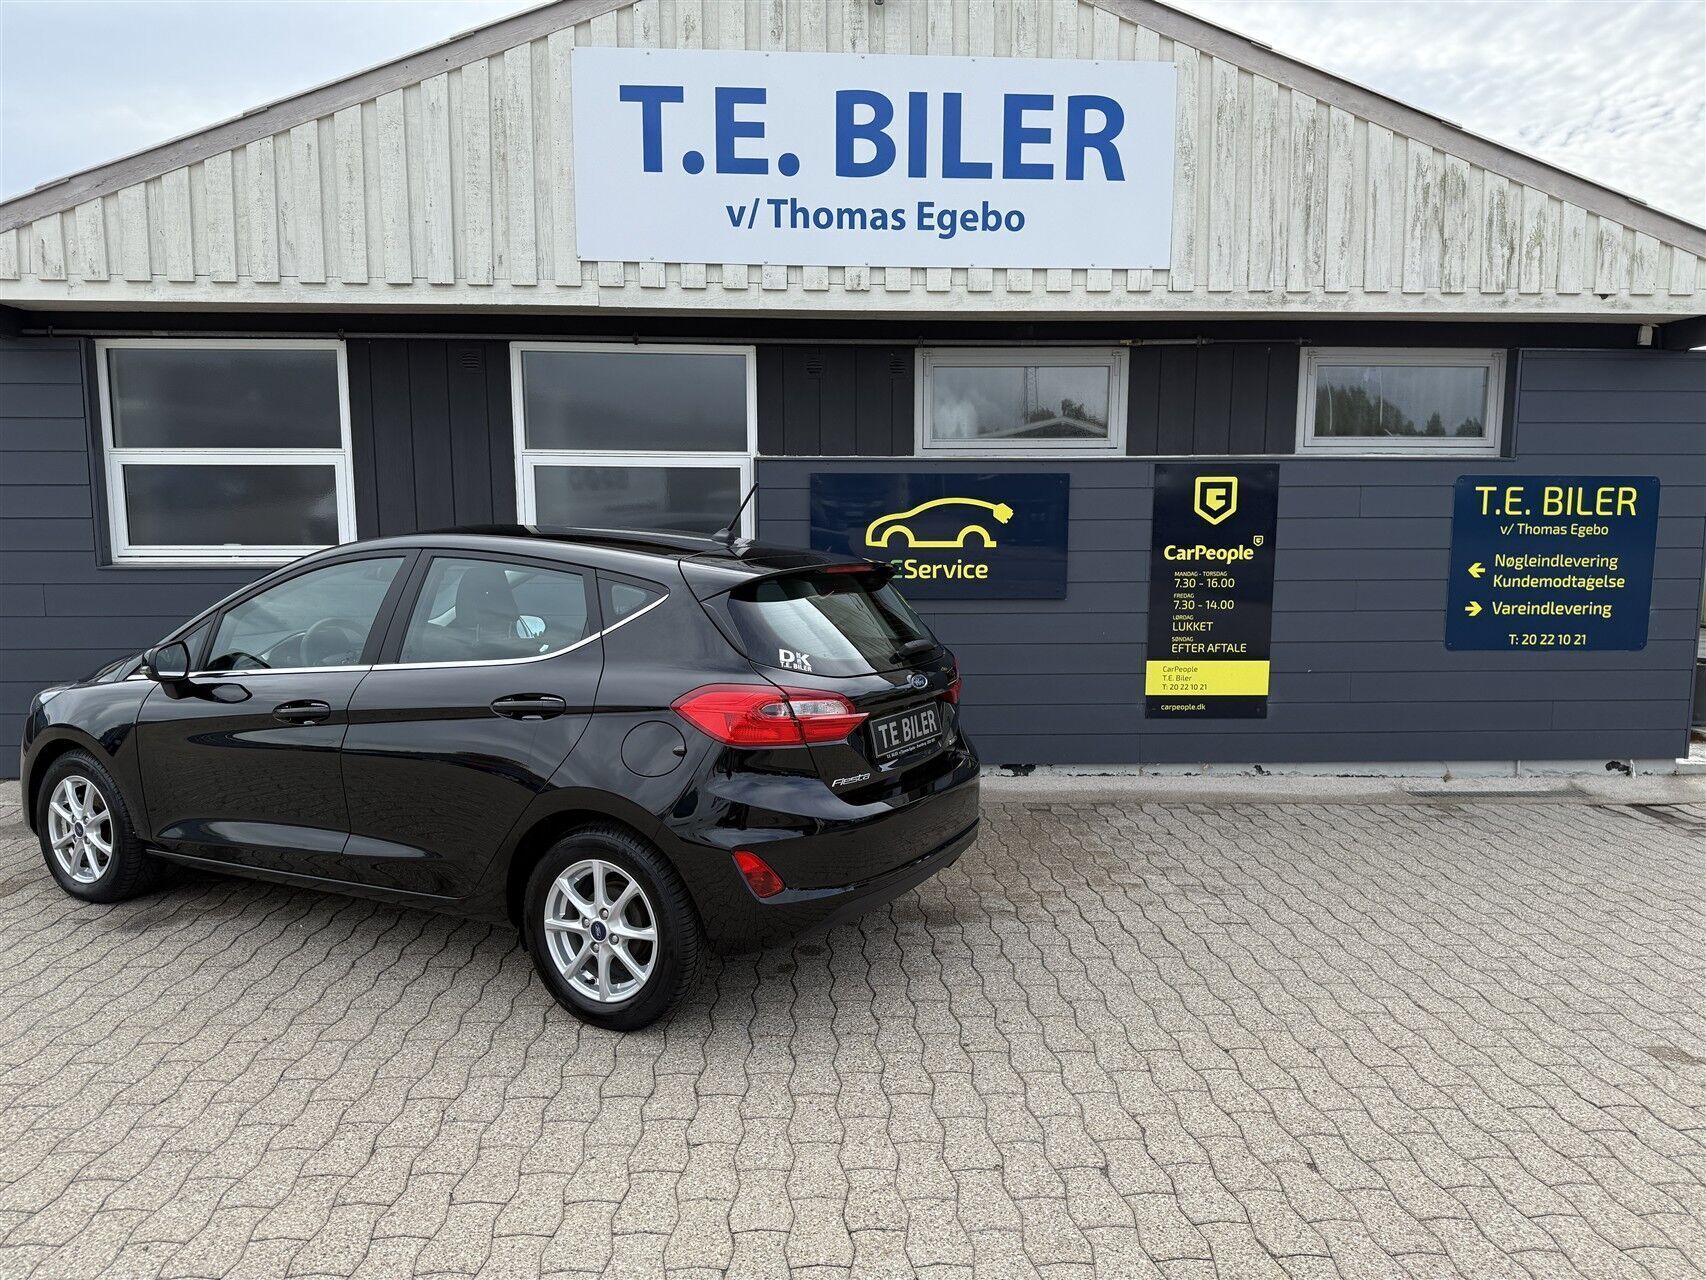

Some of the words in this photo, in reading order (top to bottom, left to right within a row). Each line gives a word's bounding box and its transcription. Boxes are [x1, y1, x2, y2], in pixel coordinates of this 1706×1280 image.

[619, 84, 801, 177] T.E.
[835, 89, 1126, 182] BILER
[725, 198, 760, 230] v/
[767, 198, 907, 232] Thomas
[916, 201, 1026, 240] Egebo
[1475, 486, 1531, 516] T.E.
[1543, 486, 1637, 516] BILER
[1500, 523, 1515, 536] v/
[1517, 523, 1567, 535] Thomas
[1570, 523, 1609, 538] Egebo
[1163, 544, 1254, 565] CarPeople
[1494, 553, 1619, 570] Nøgleindlevering
[1174, 578, 1196, 588] 7.30
[1206, 578, 1235, 588] 16.00
[1493, 574, 1625, 591] Kundemodtagelse
[1173, 599, 1195, 610] 7.30
[1205, 599, 1235, 610] 14.00
[1492, 601, 1613, 618] Vareindlevering
[1172, 621, 1214, 632] LUKKET
[1171, 643, 1205, 653] EFTER
[1206, 643, 1247, 653] AFTALE
[1508, 634, 1519, 646] T:
[1521, 634, 1537, 646] 20
[1539, 634, 1555, 646] 22
[1557, 634, 1571, 646] 10
[1573, 634, 1587, 646] 21
[778, 648, 812, 667] DK
[1162, 665, 1199, 673] CarPeople
[1162, 674, 1175, 682] T.E.
[1176, 674, 1192, 682] Biler
[1160, 703, 1206, 712] carpeople.dk
[902, 709, 938, 742] BILER
[831, 772, 871, 788] Fiesta
